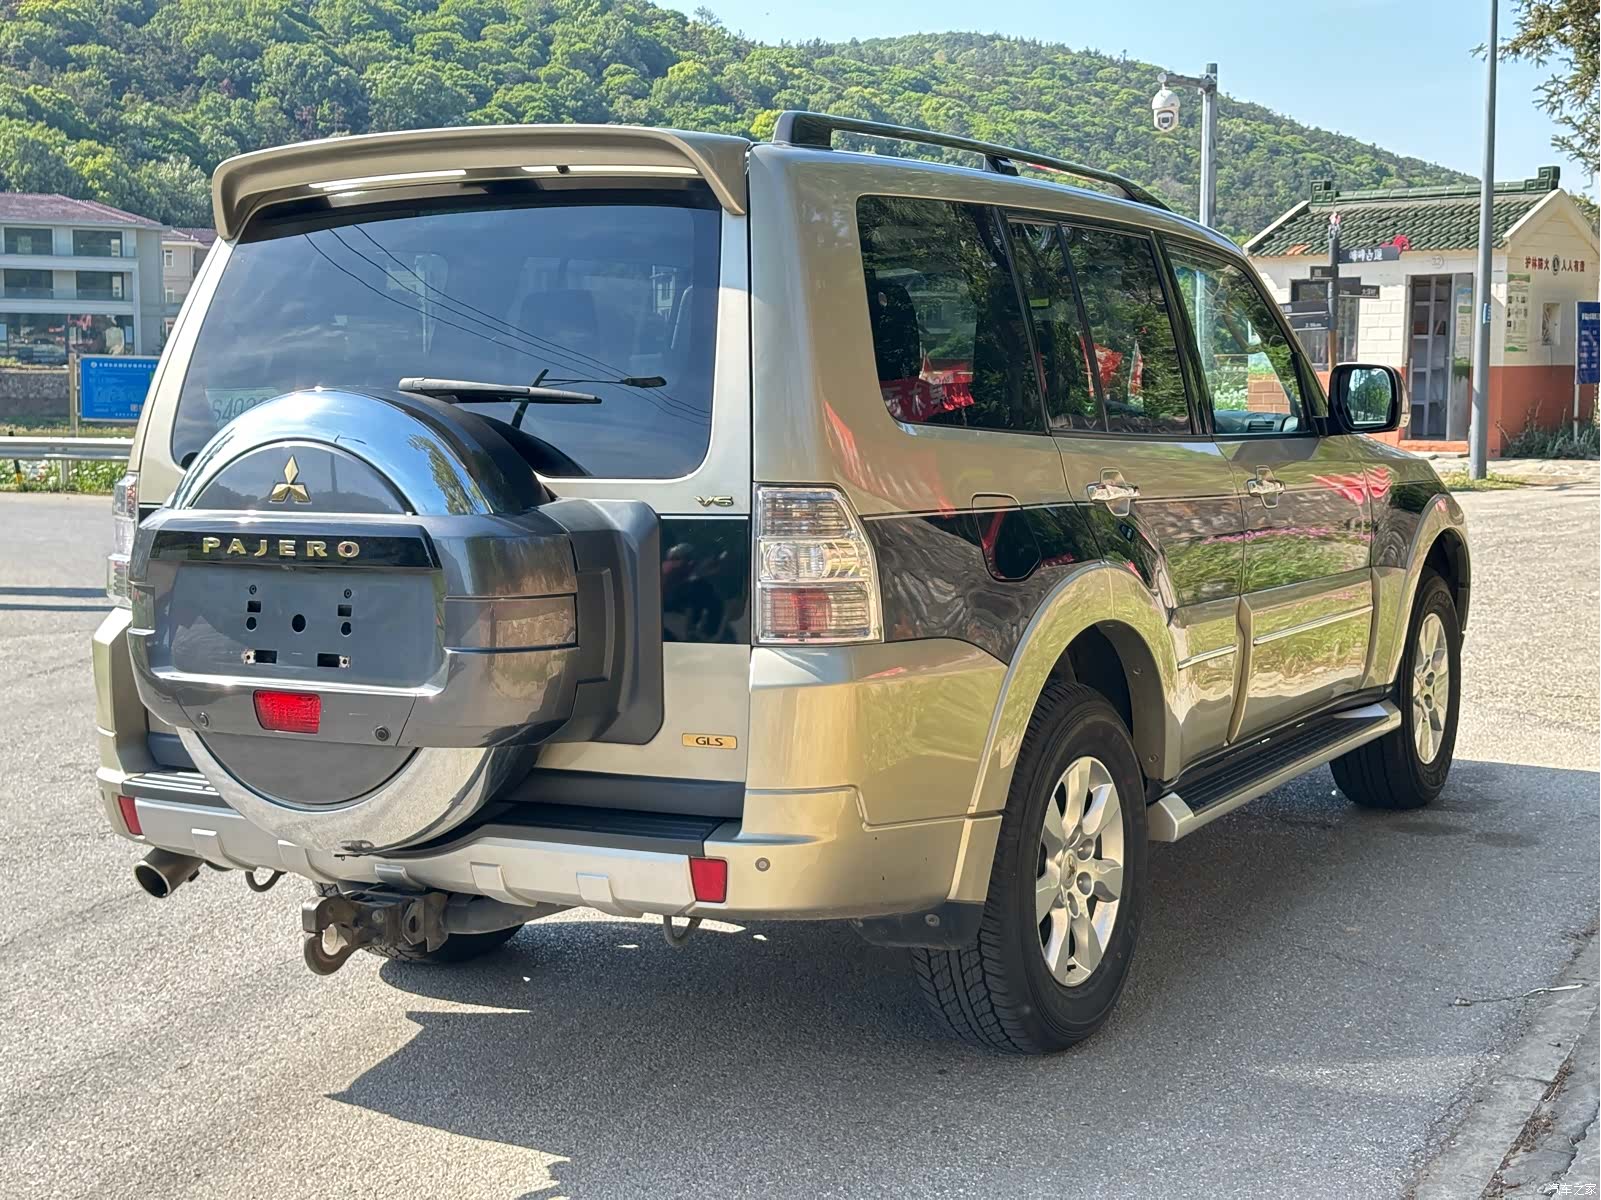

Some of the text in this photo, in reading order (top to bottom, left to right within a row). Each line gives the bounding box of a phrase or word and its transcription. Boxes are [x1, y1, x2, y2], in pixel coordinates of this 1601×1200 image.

[694, 496, 734, 507] V6
[202, 536, 360, 558] PAJERO
[695, 736, 724, 747] GLS
